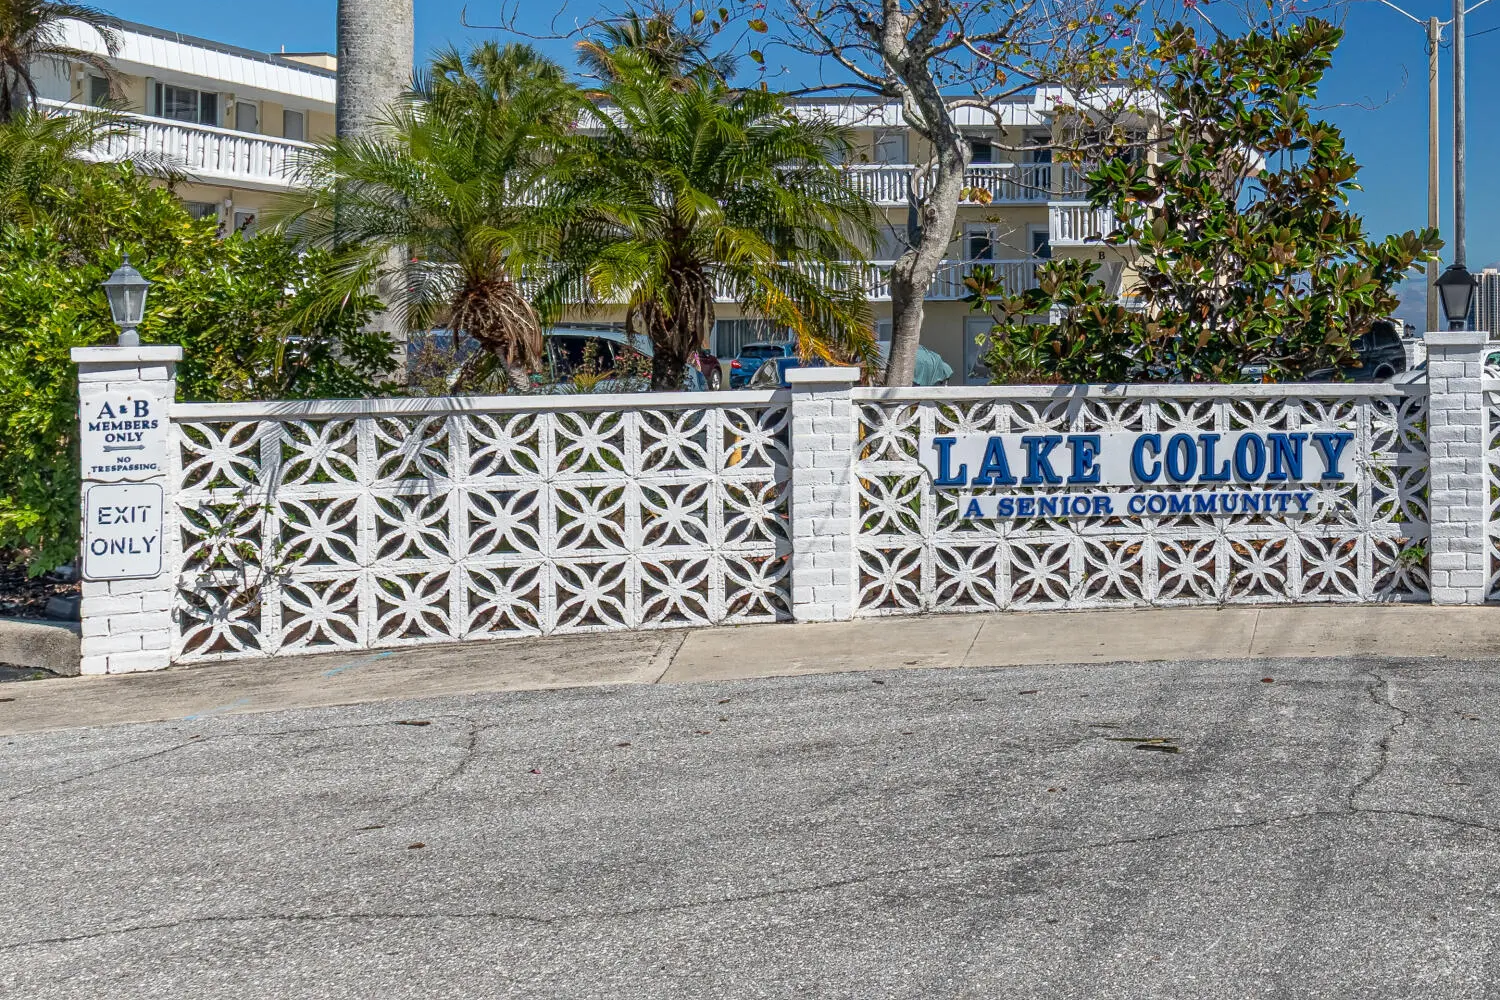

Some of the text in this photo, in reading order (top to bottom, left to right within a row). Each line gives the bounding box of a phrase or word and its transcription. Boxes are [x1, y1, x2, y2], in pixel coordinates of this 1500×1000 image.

[1099, 251, 1105, 260] B
[97, 401, 116, 419] A
[134, 400, 149, 418] B
[88, 420, 159, 431] MEMBERS
[105, 432, 144, 443] ONLY
[91, 463, 157, 473] TRESPASSING
[932, 432, 1354, 487] LAKE COLONY
[98, 505, 151, 525] EXIT
[963, 493, 1314, 518] A SENIOR COMMUNITY
[91, 535, 156, 556] ONLY
